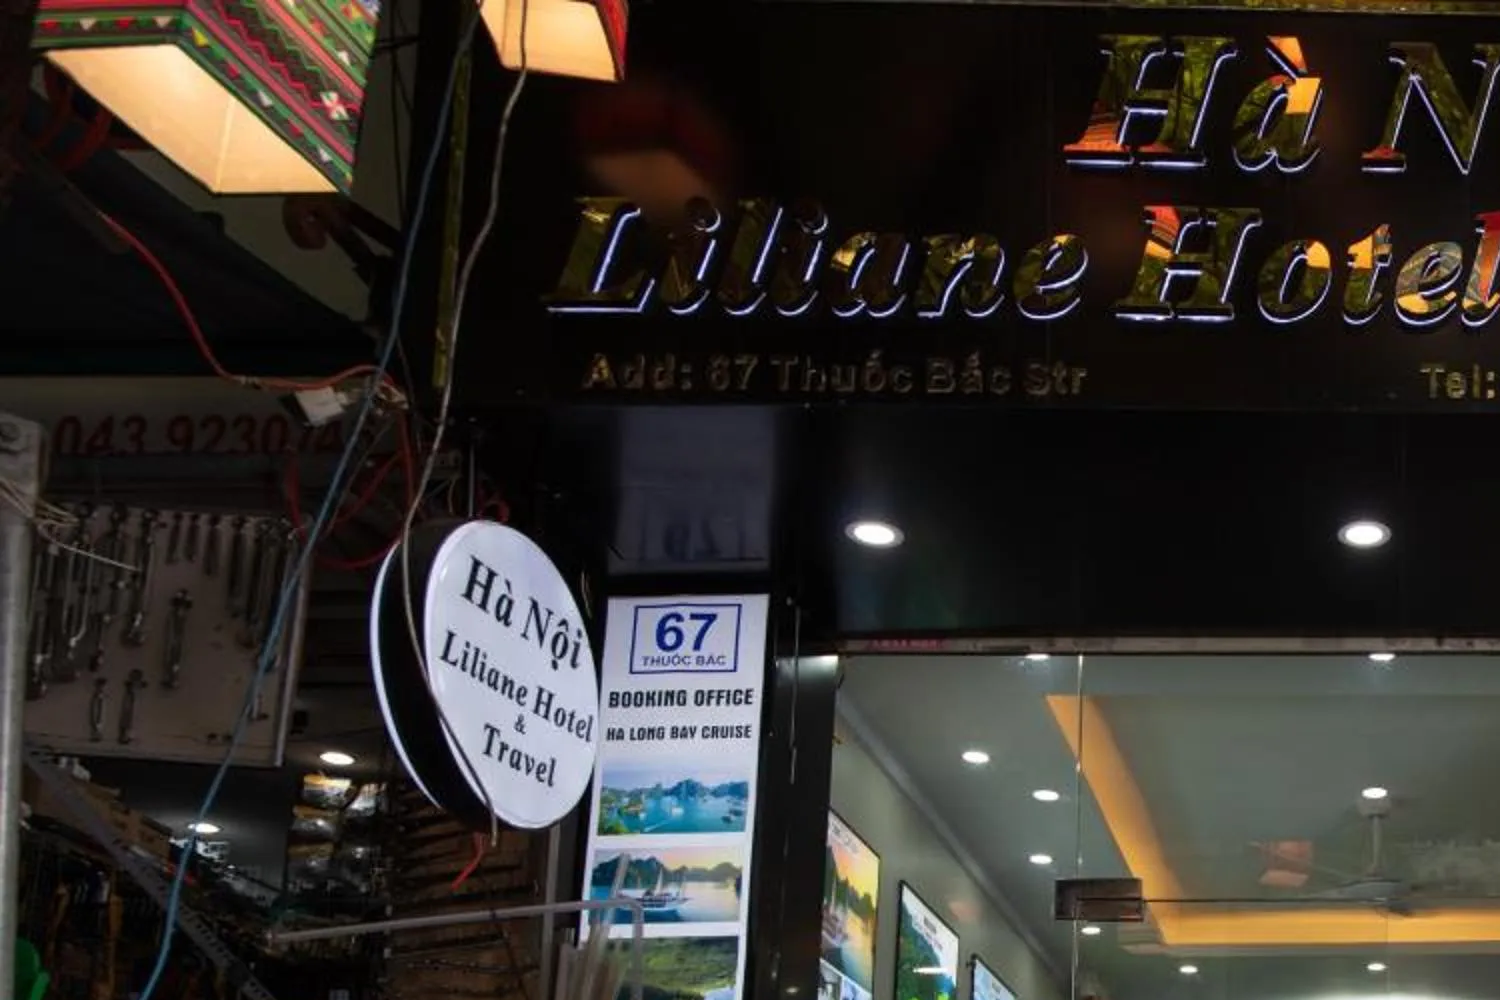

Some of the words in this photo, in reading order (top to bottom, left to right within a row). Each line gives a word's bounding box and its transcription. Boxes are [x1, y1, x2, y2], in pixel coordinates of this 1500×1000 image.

[1062, 33, 1324, 173] Hà
[543, 194, 1088, 320] Liliane
[580, 351, 693, 391] Add:
[1022, 360, 1089, 395] Str
[1420, 363, 1496, 400] Tel:
[461, 554, 513, 628] Hà
[520, 597, 584, 672] Nội
[655, 611, 718, 653] 67
[439, 630, 528, 708] Liliane
[532, 685, 594, 743] Hotel
[608, 689, 688, 708] BOOKING
[693, 687, 755, 707] OFFICE
[513, 715, 526, 736] &
[606, 727, 625, 742] HA
[629, 726, 666, 742] LONG
[669, 725, 698, 740] BAY
[701, 724, 753, 740] CRUISE
[481, 722, 556, 788] Travel
